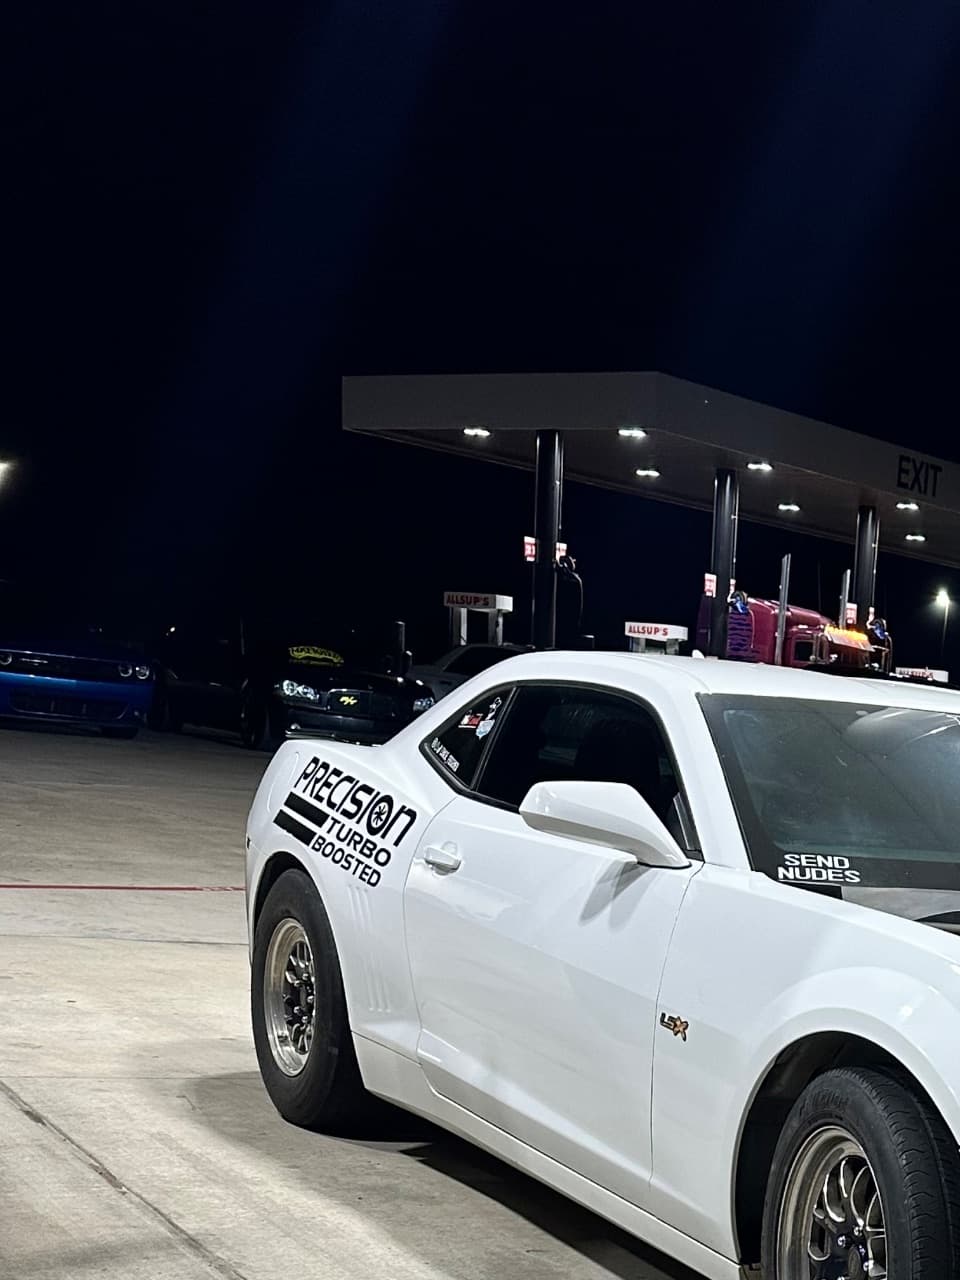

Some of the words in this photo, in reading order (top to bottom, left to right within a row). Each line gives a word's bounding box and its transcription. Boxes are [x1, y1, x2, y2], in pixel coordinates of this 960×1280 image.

[897, 454, 943, 497] EXIT
[446, 594, 490, 606] ALLSUP'S
[627, 624, 669, 637] ALLSUP'S
[326, 815, 392, 868] TURBO
[311, 834, 382, 888] BOOSTED
[783, 853, 850, 869] SEND
[777, 866, 861, 883] NUDES
